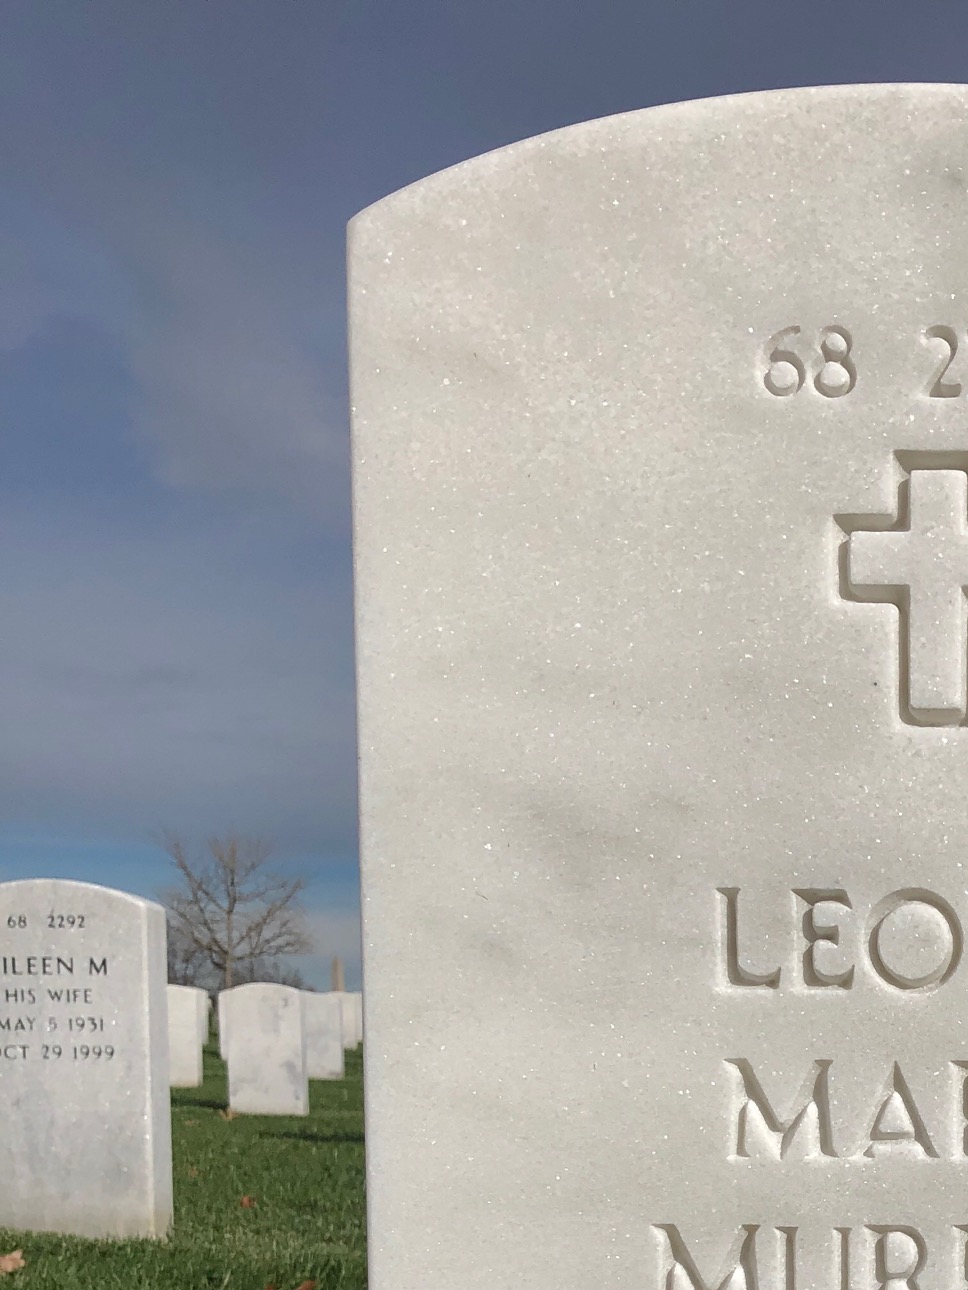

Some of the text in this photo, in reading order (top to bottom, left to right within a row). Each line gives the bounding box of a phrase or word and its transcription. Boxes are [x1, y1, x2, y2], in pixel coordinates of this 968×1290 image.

[764, 324, 857, 398] 68
[7, 914, 86, 929] 68 2292
[88, 956, 108, 976] M
[5, 988, 93, 1004] HIS WIFE
[68, 1016, 104, 1033] 1931
[0, 1043, 115, 1062] CT 29 1999
